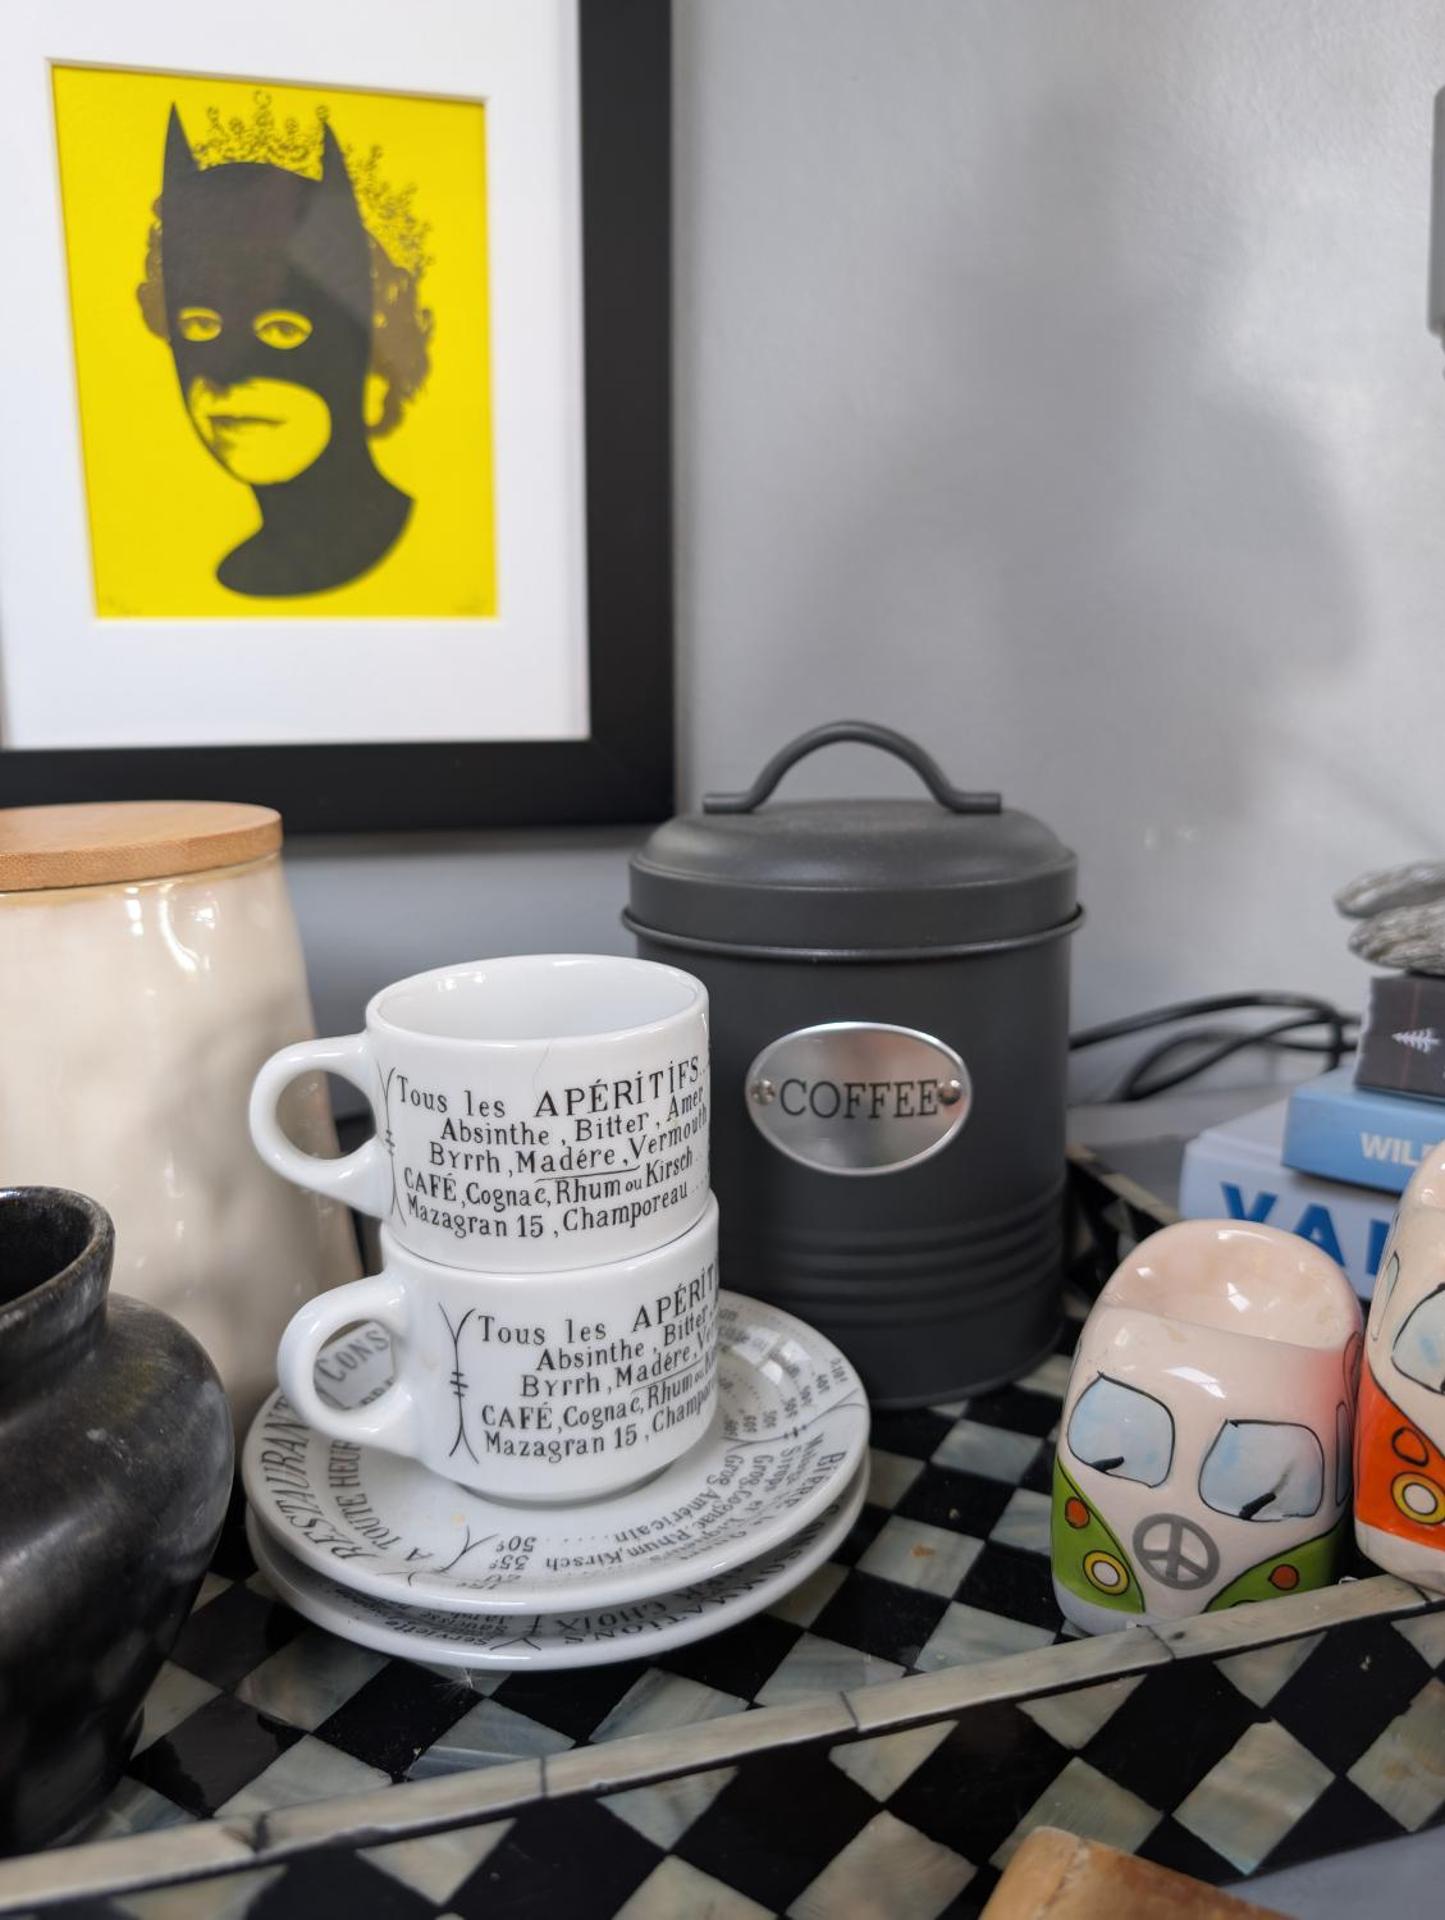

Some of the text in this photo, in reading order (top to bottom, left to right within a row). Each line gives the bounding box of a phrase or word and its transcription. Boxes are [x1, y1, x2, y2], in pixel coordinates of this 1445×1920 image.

[397, 1074, 448, 1114] Tous
[464, 1090, 506, 1118] les
[780, 1079, 940, 1119] COFFEE
[628, 1102, 708, 1160] Vermouth
[625, 1179, 642, 1194] ou
[646, 1145, 694, 1188] Kirsch
[407, 1194, 508, 1239] Mazagran
[562, 1181, 688, 1233] Champoreau
[478, 1315, 545, 1346] Tous
[566, 1318, 607, 1344] les
[632, 1262, 717, 1334] APÉRIT
[485, 1431, 605, 1464] Mazagran
